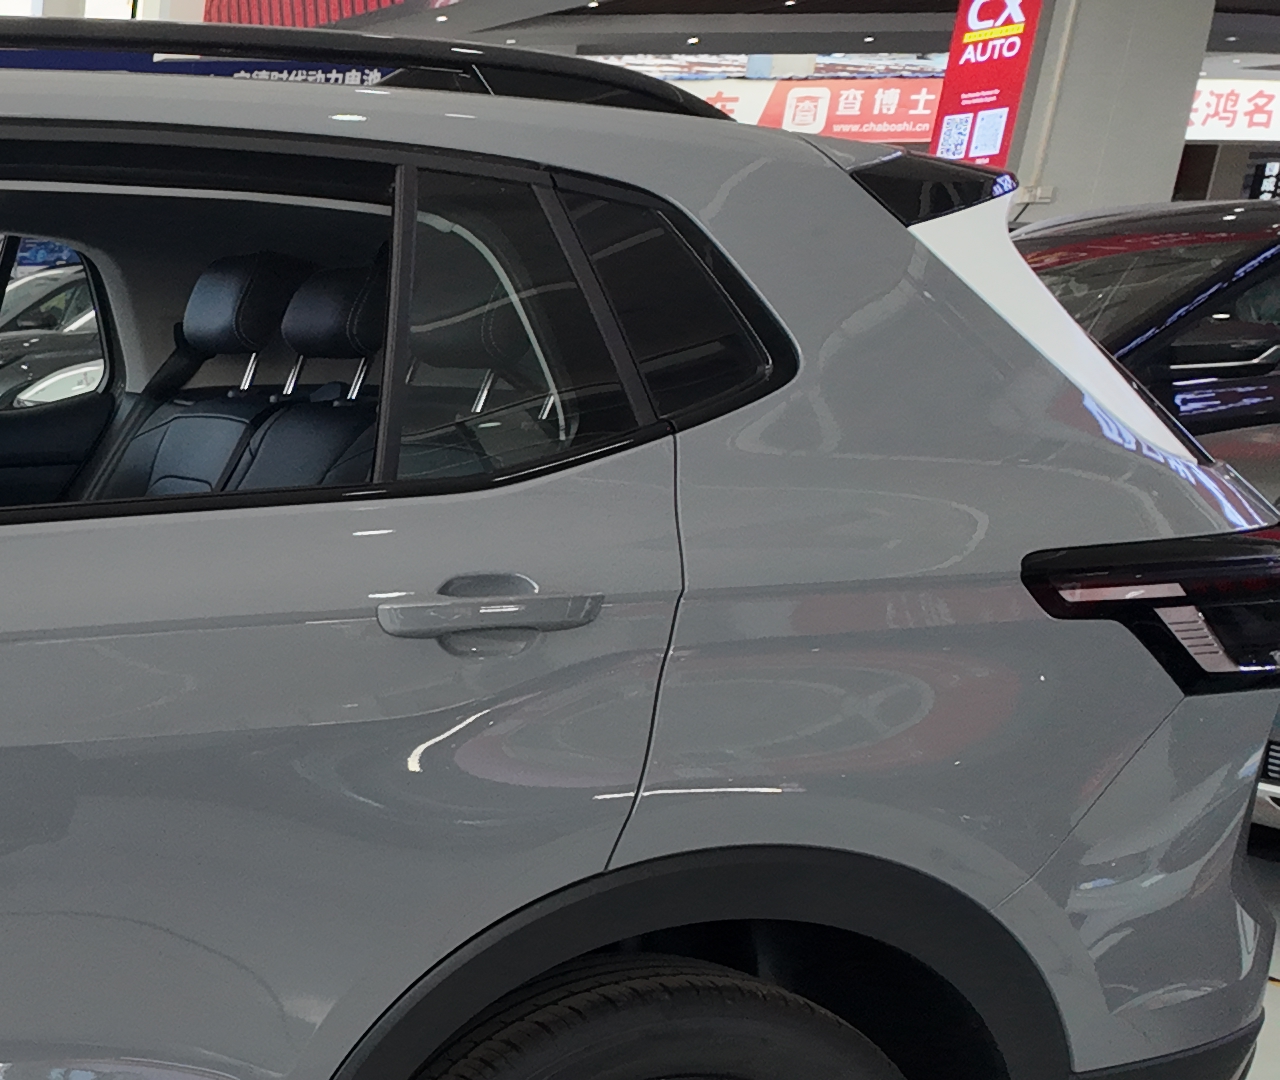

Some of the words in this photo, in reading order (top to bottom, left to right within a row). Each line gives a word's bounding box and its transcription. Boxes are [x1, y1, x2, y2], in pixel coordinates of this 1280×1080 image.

[967, 0, 1026, 31] CX
[958, 36, 1022, 65] AUTO
[836, 87, 937, 115] 查博士
[832, 121, 931, 133] www.chaboshi.cn
